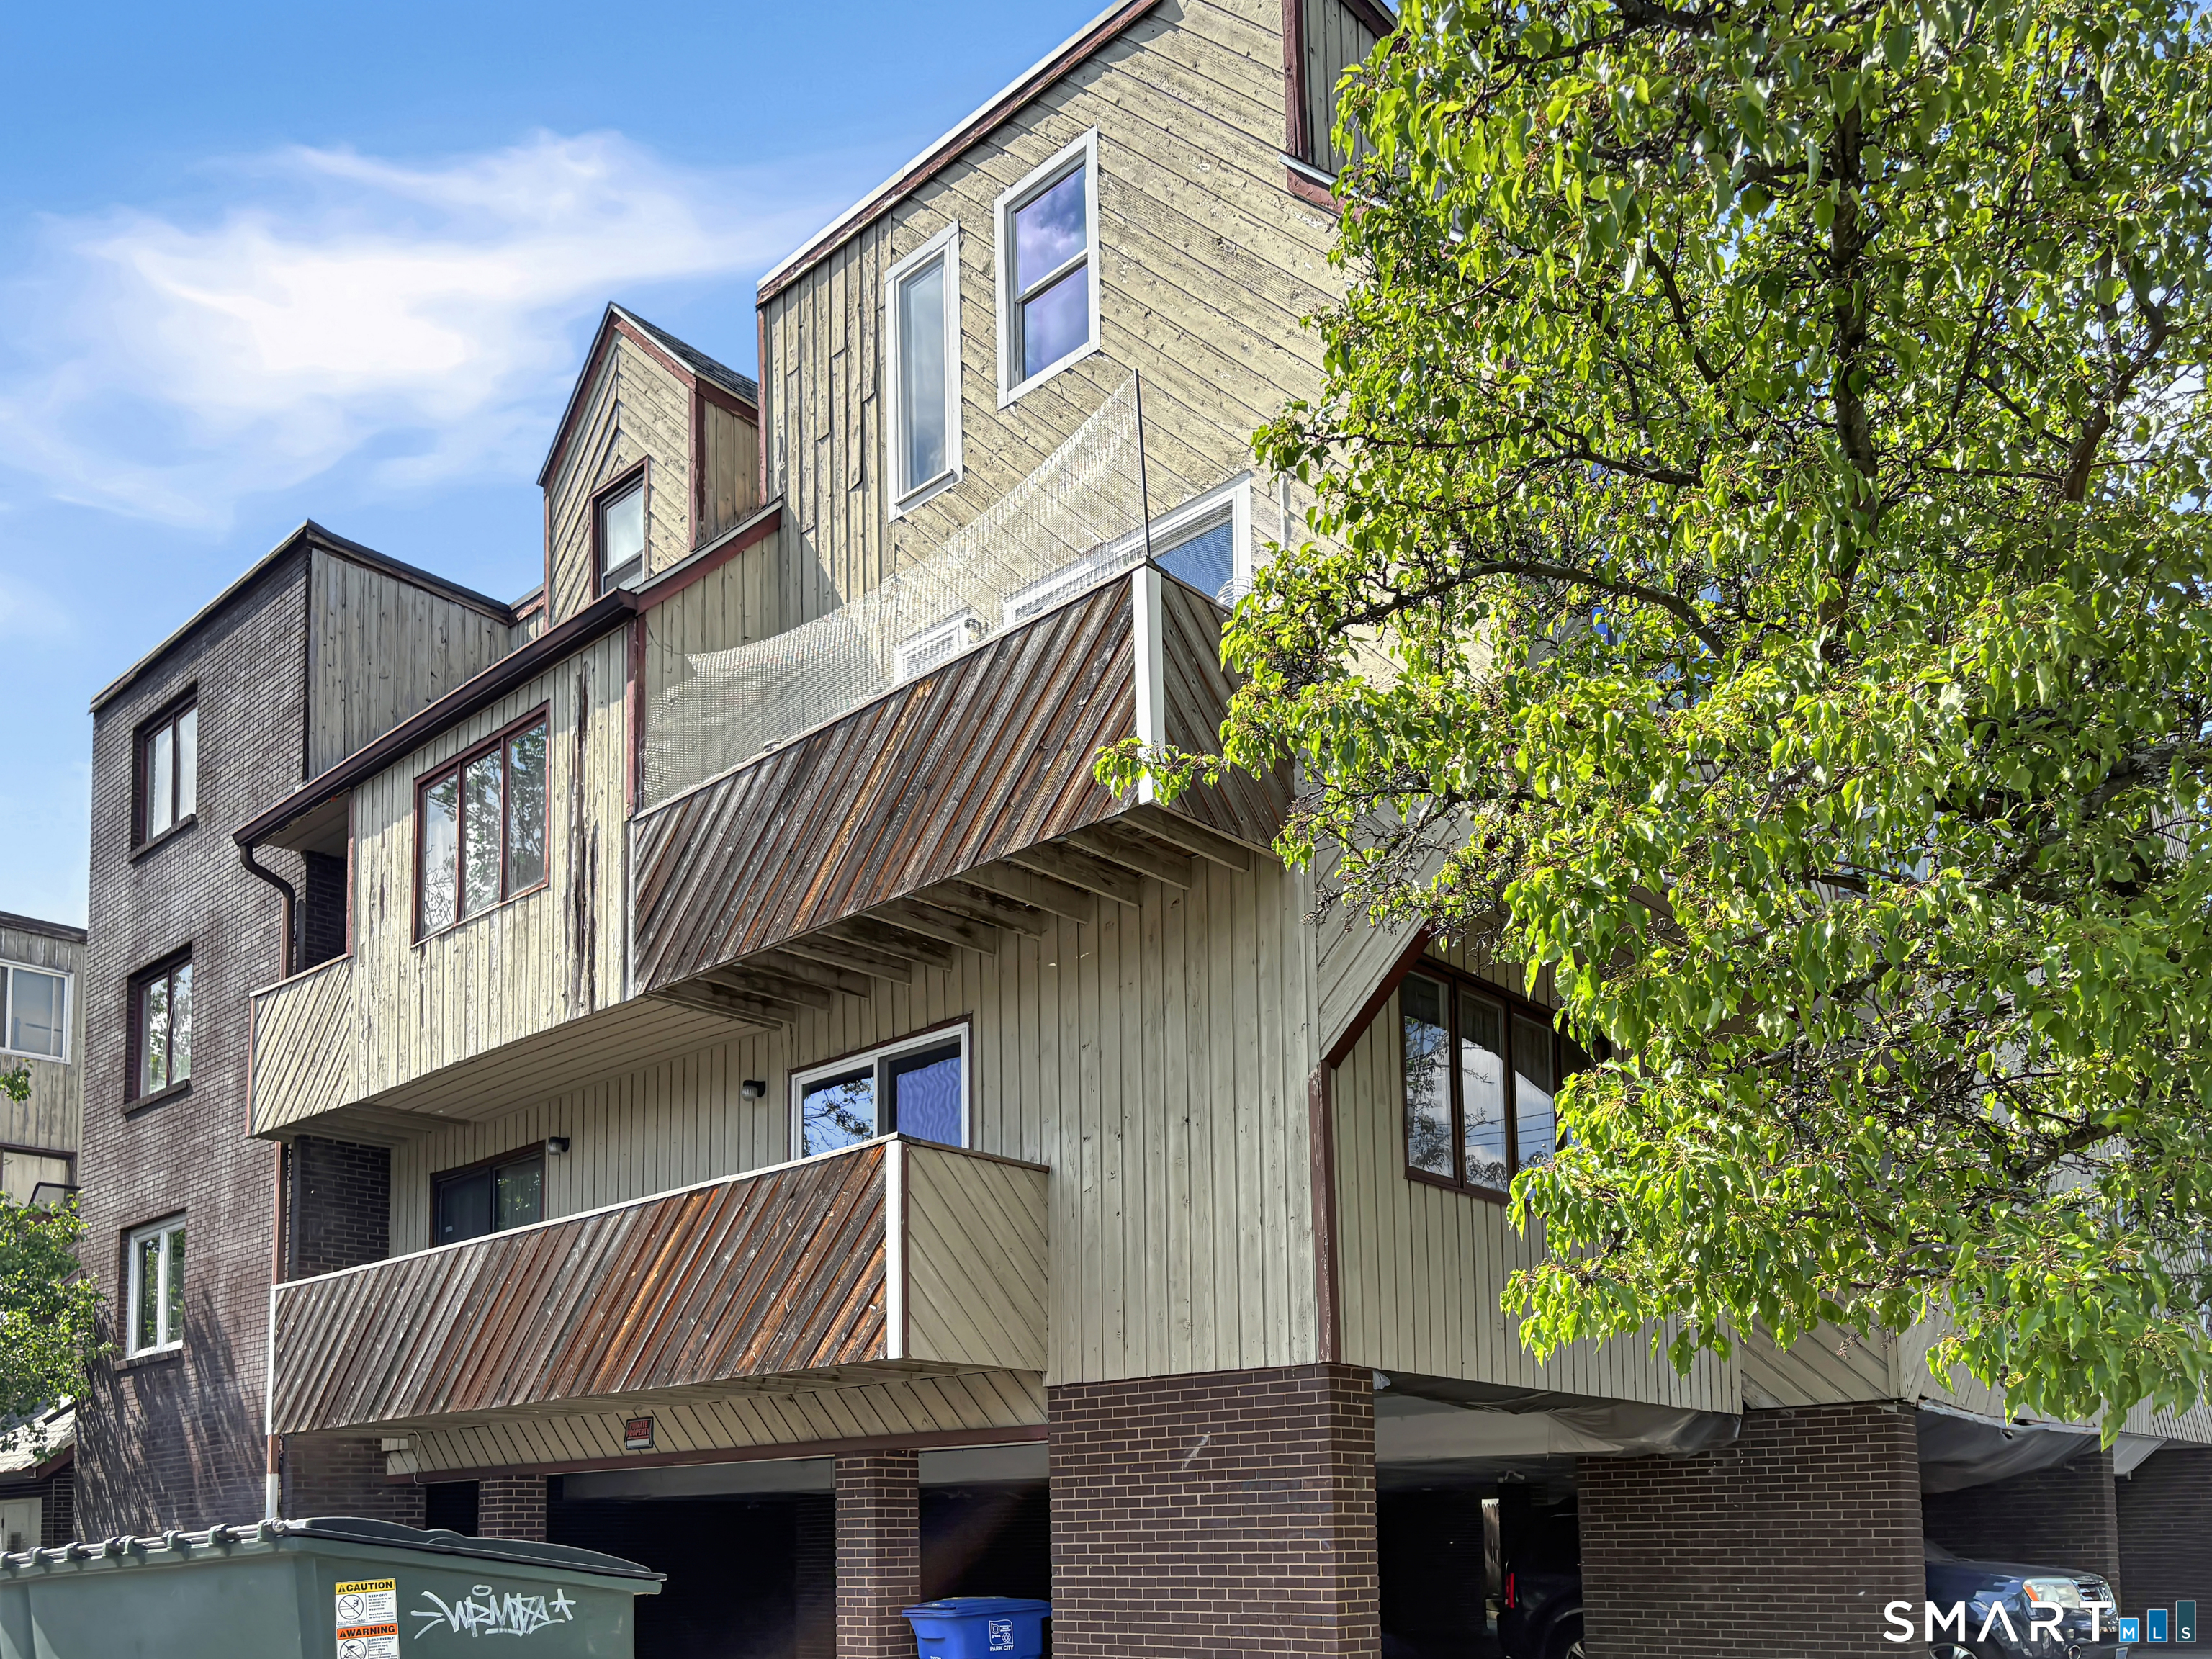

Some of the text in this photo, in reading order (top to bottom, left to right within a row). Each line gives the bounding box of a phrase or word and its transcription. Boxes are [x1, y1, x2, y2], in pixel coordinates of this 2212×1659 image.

[628, 1428, 649, 1437] PROPERTY
[346, 1581, 392, 1592] CAUTION
[346, 1626, 395, 1637] WARNING
